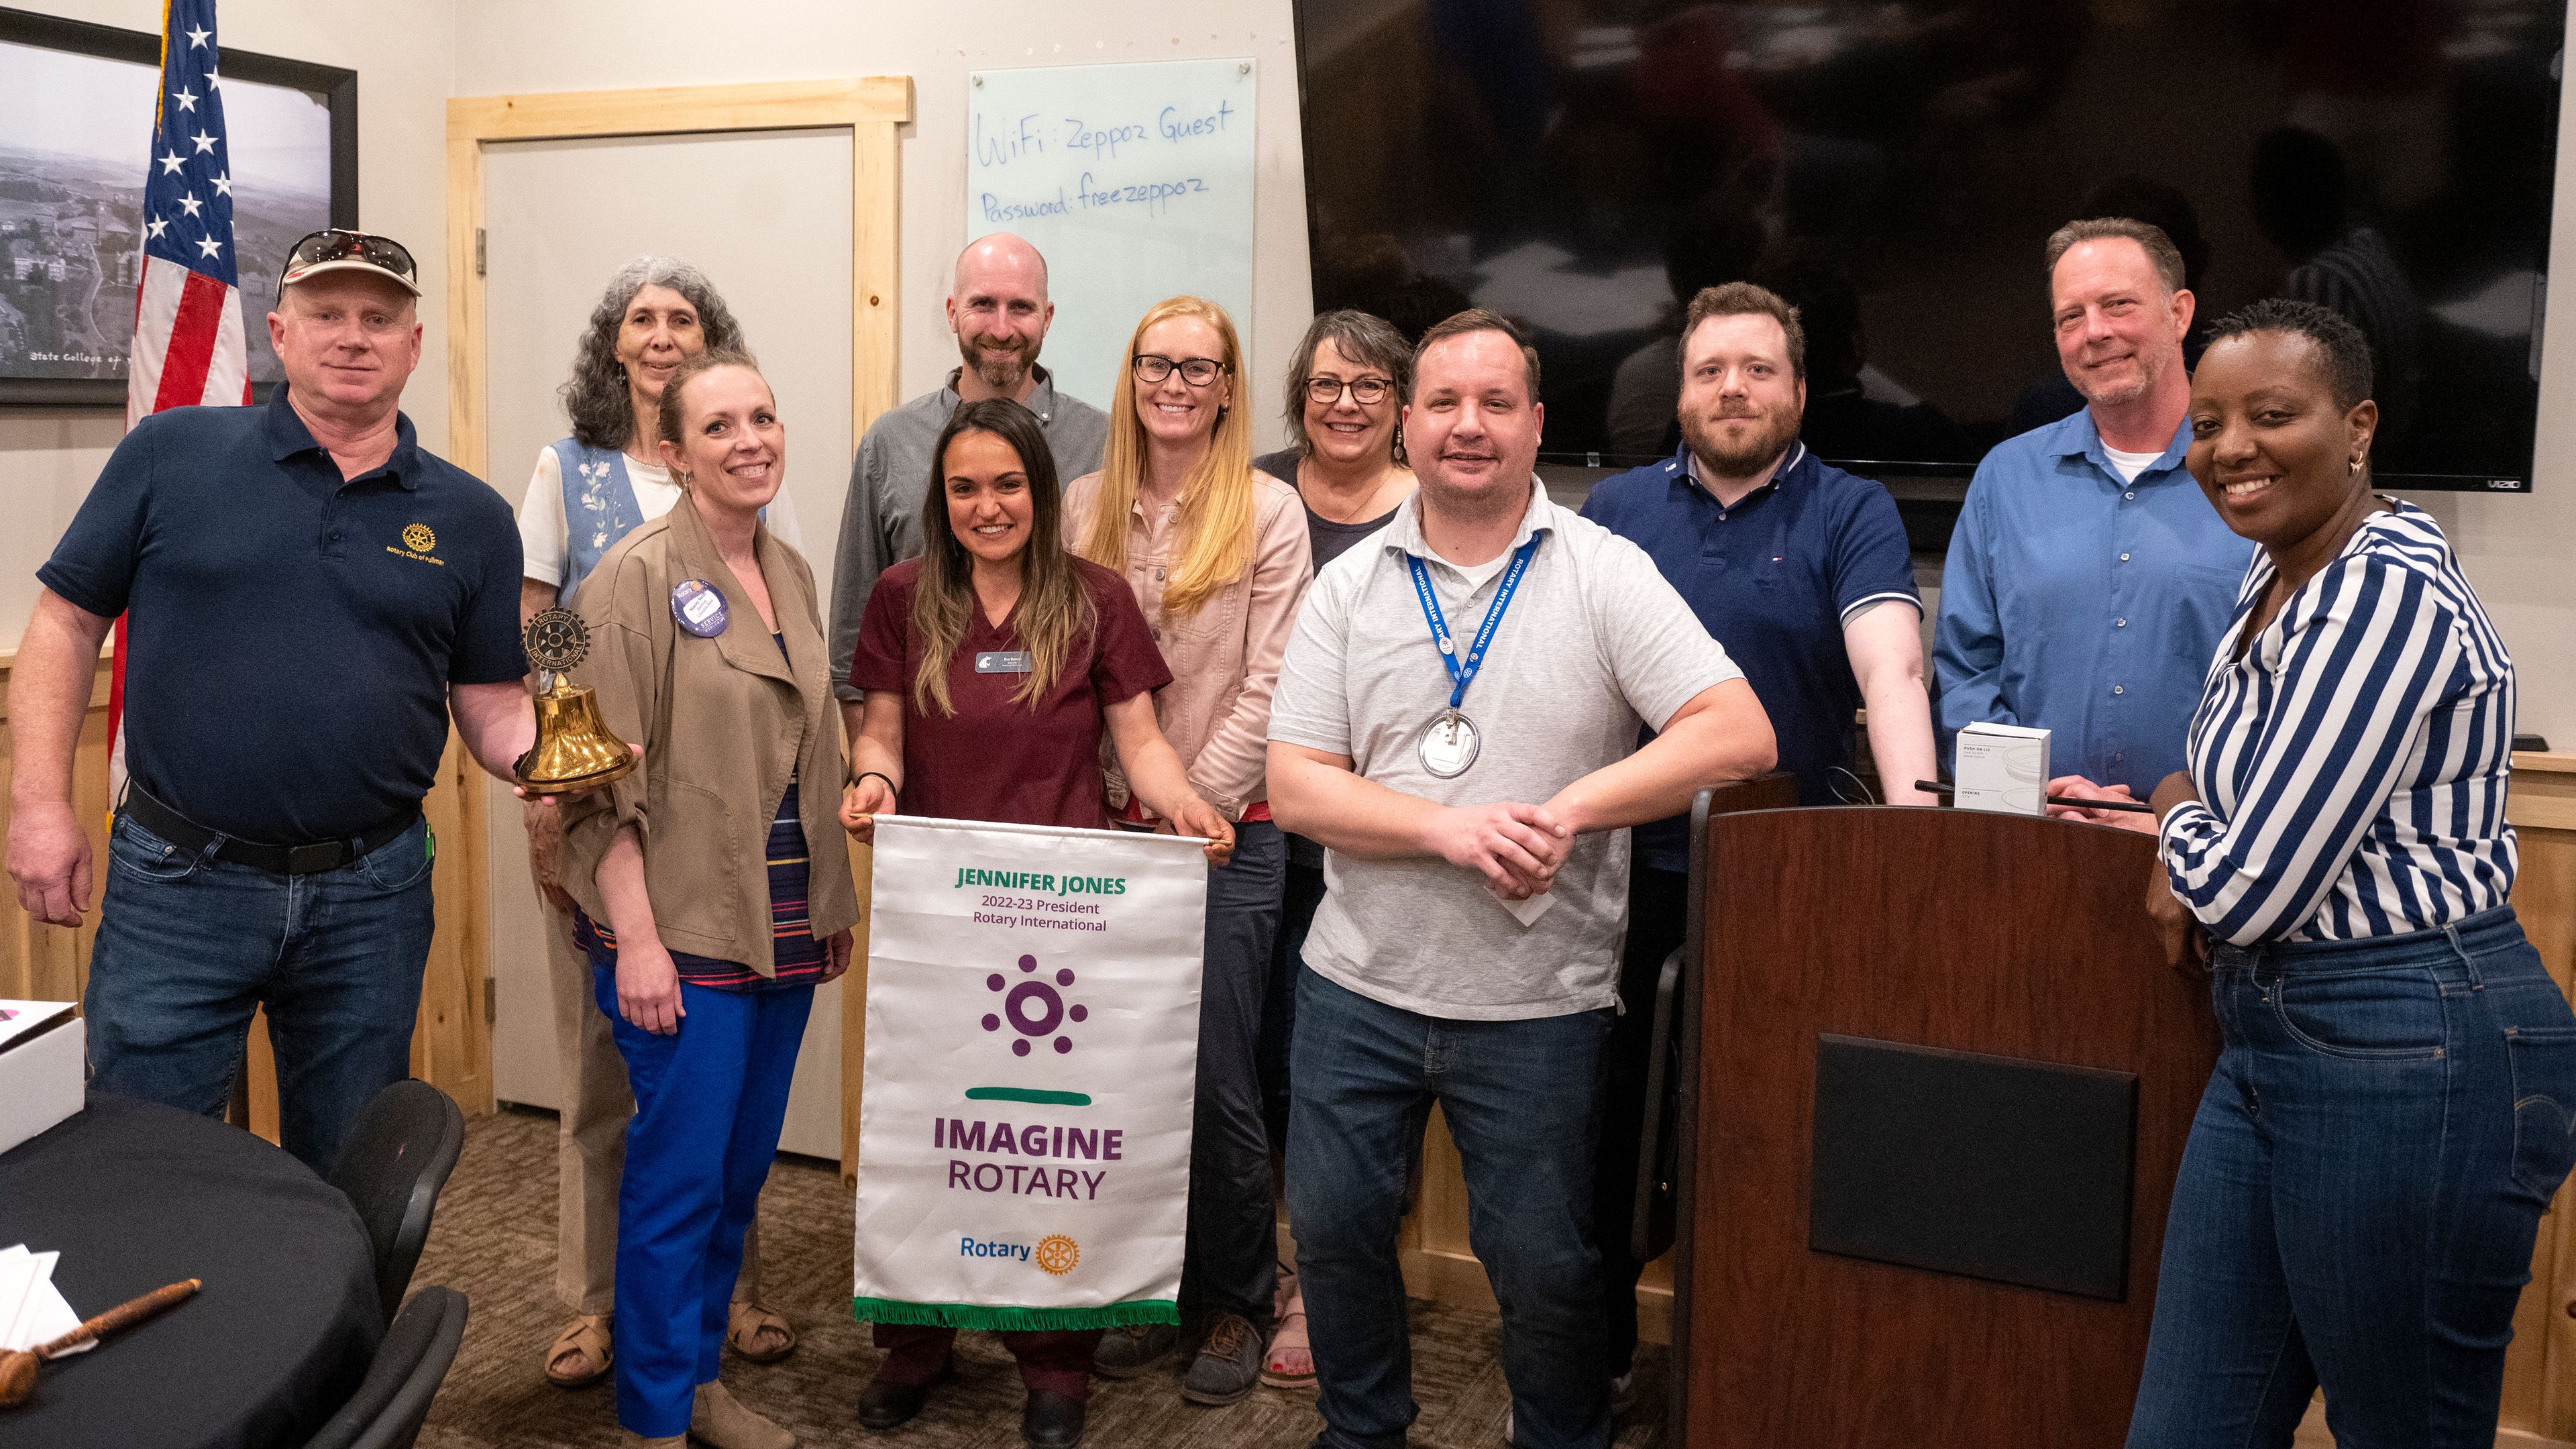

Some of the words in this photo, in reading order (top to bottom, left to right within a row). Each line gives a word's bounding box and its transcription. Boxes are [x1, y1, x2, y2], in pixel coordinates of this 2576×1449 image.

[1065, 117, 1148, 160] Zeppoz
[1159, 99, 1235, 144] Guest
[981, 186, 1073, 223] Password:
[30, 352, 59, 361] State
[63, 352, 102, 365] College
[108, 355, 121, 371] of
[387, 547, 405, 557] Rotary
[1505, 558, 1524, 588] ROTARY
[677, 588, 692, 598] Rotary
[1415, 566, 1438, 623] INTERNATIONAL
[538, 614, 568, 625] ROTARY
[700, 611, 723, 629] SERVICE
[1477, 589, 1509, 649] INTERNATIONAL
[532, 647, 582, 666] INTERNATIONAL
[955, 867, 1055, 892] JENNIFER
[1059, 873, 1126, 896] JONES
[981, 895, 1034, 911] 2022-23
[1036, 898, 1100, 915] President
[973, 911, 1017, 929] Rotary
[1020, 913, 1107, 932] International
[934, 1117, 1123, 1161] IMAGINE
[948, 1159, 1107, 1201] ROTARY
[961, 1237, 1031, 1263] Rotary
